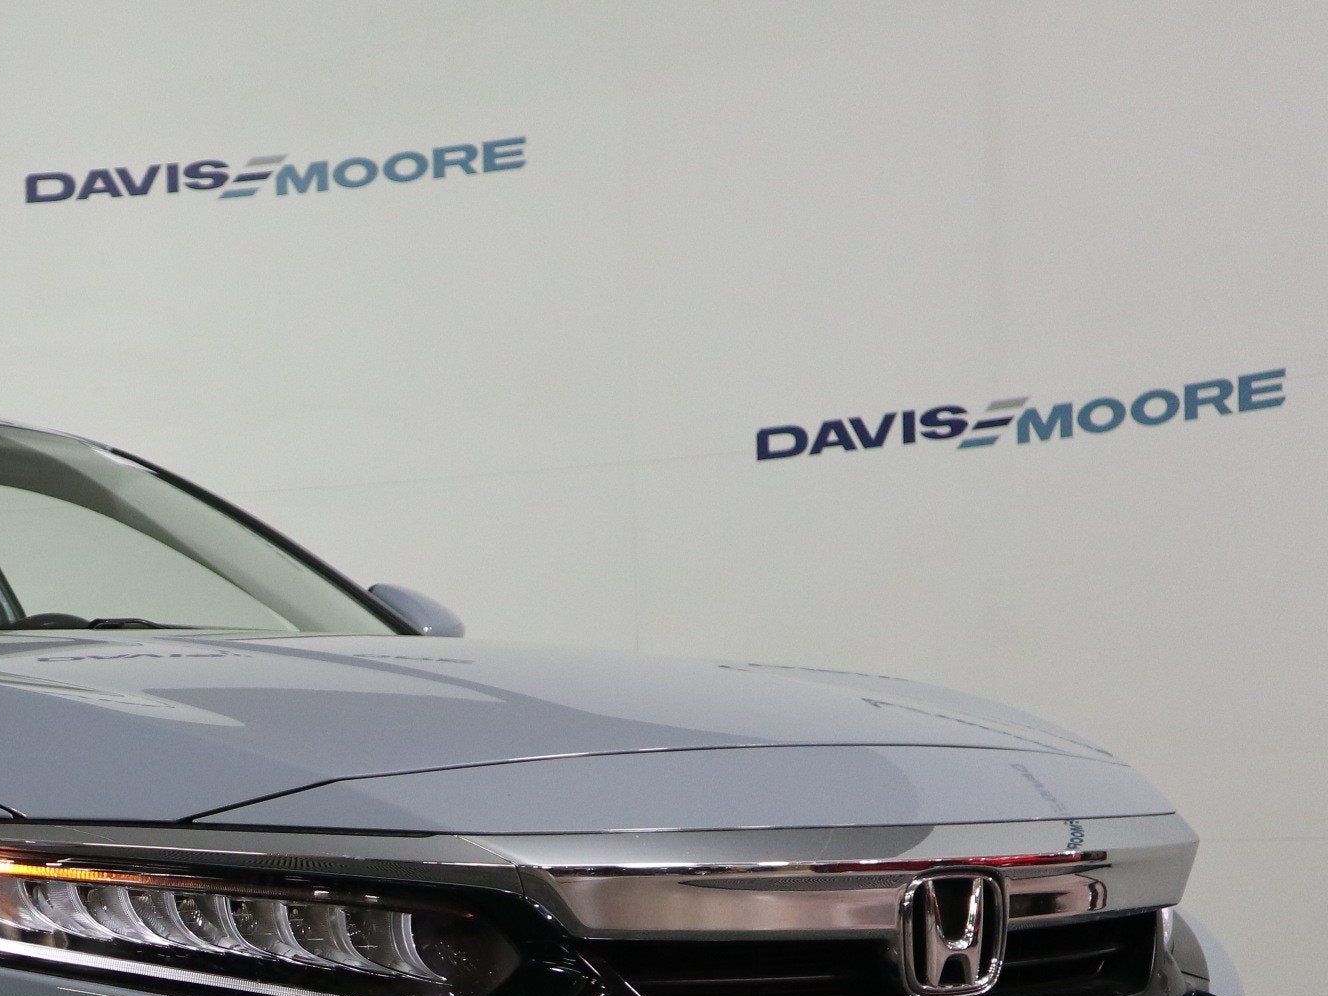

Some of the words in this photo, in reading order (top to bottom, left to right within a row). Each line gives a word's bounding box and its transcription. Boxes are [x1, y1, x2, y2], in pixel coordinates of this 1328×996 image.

[25, 159, 230, 203] DAVIS
[275, 136, 527, 196] MOORE
[756, 405, 969, 461] DAVIS
[1016, 368, 1287, 444] MOORE
